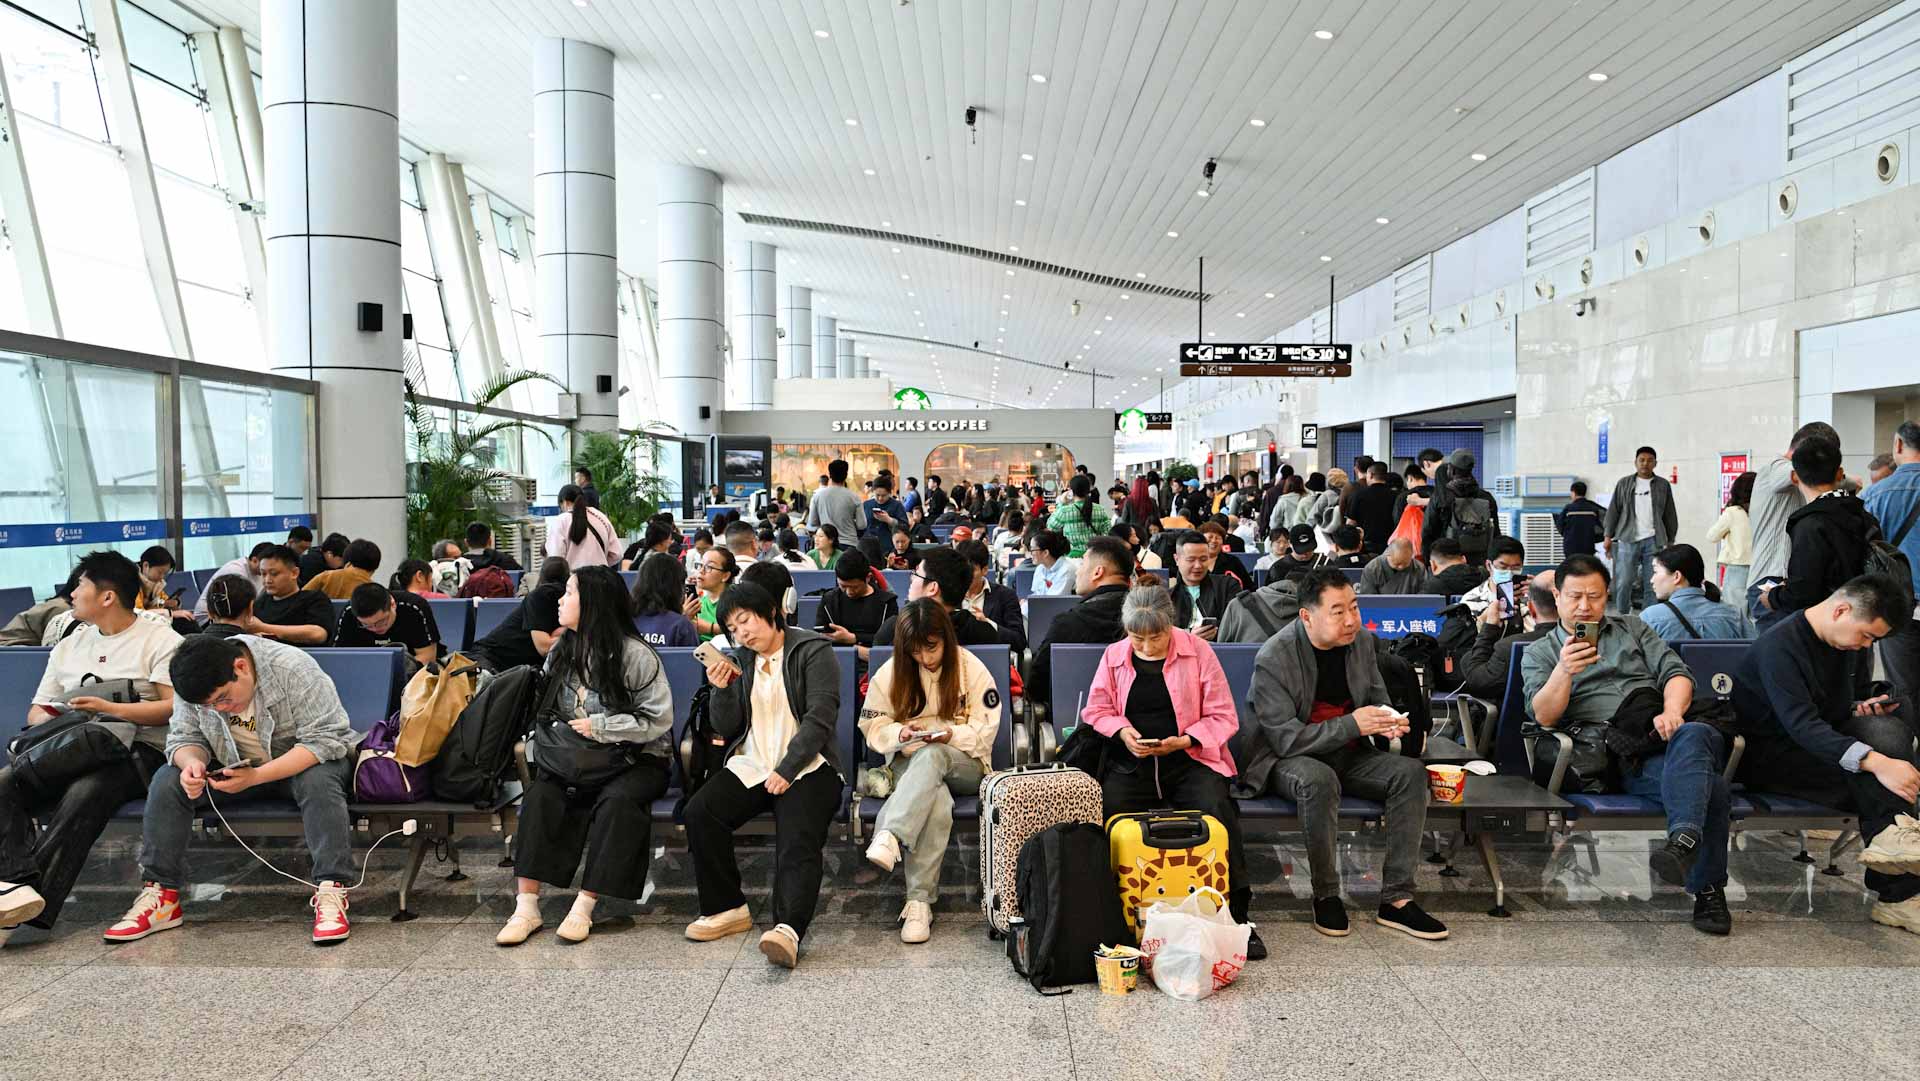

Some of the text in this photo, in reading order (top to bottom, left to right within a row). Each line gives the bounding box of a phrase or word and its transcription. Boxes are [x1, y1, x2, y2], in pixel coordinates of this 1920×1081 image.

[1255, 348, 1274, 360] 5-7
[1307, 349, 1332, 360] 9-10
[832, 419, 988, 432] STARBUCKS COFFEE
[1381, 619, 1437, 633] 军人座椅
[640, 632, 666, 645] AGA
